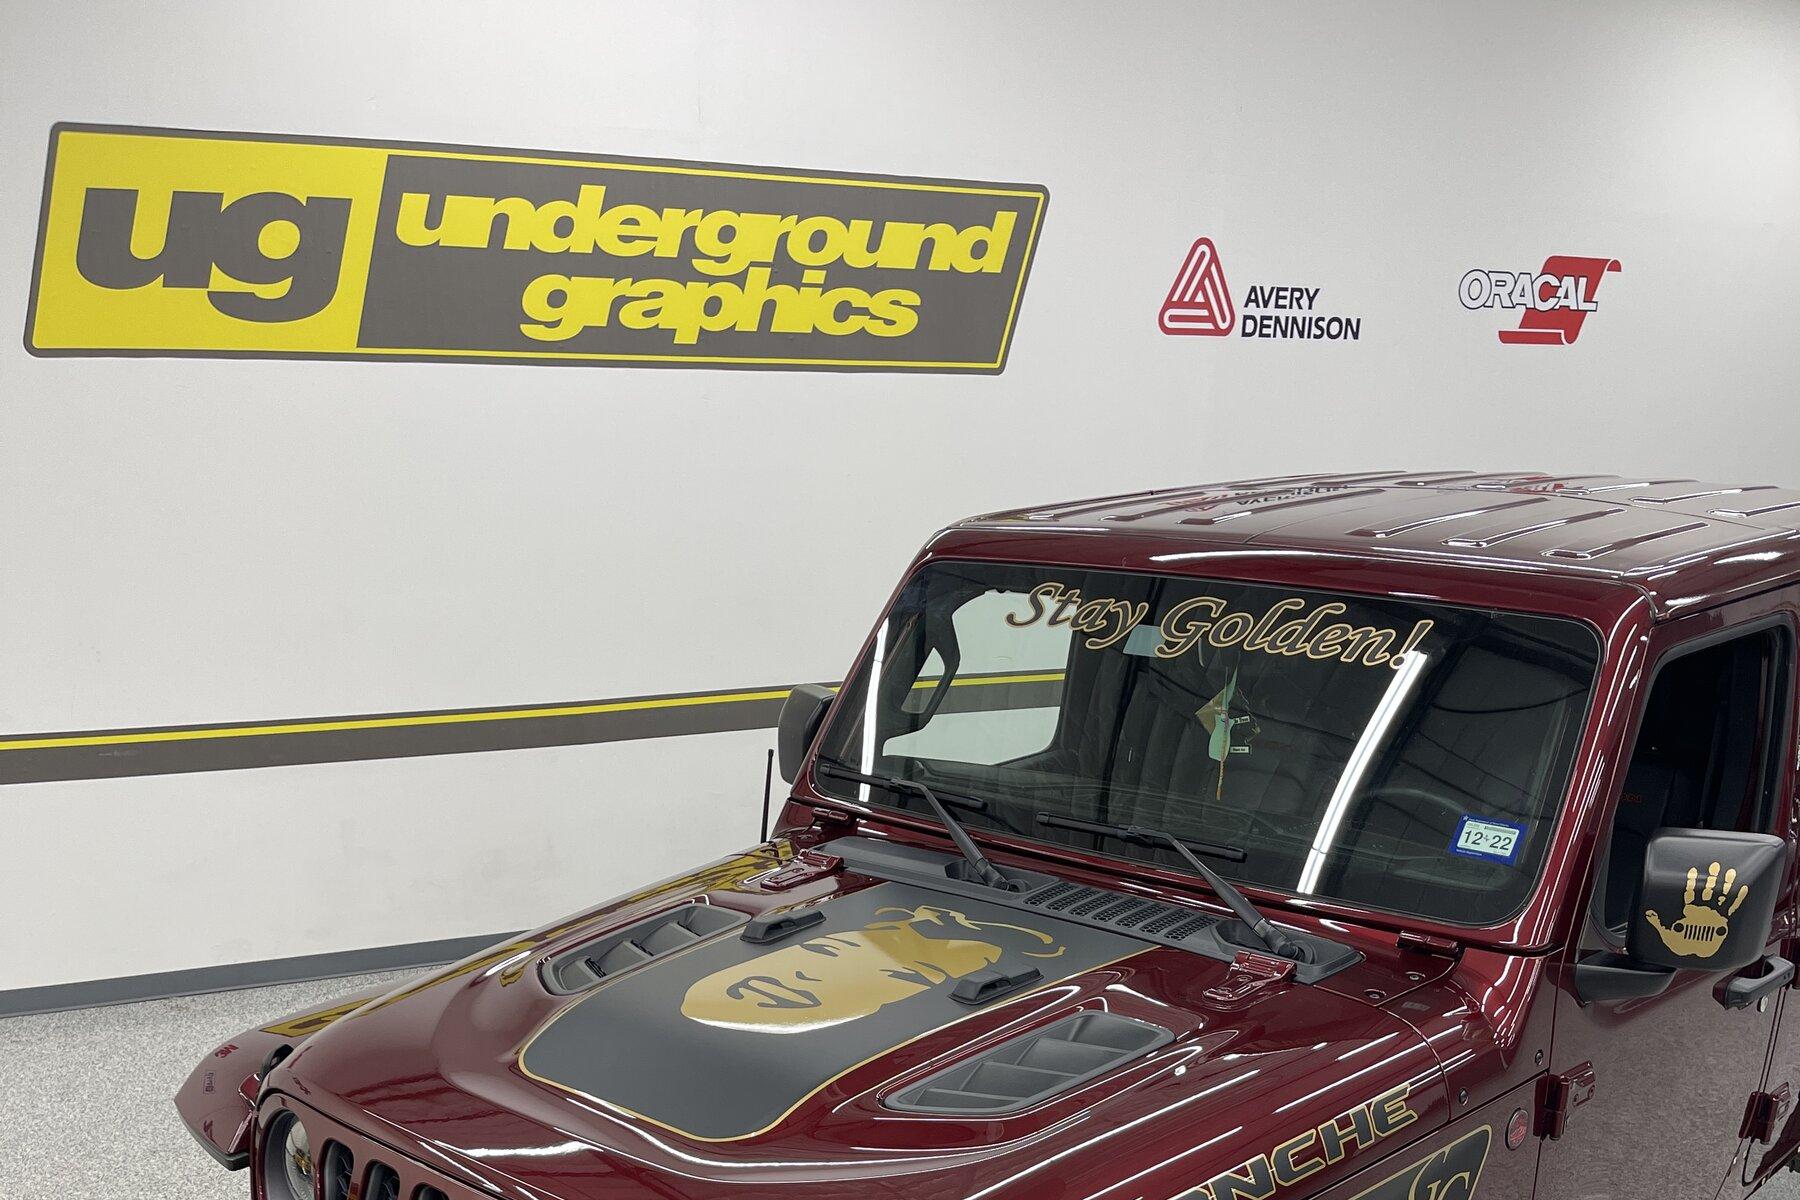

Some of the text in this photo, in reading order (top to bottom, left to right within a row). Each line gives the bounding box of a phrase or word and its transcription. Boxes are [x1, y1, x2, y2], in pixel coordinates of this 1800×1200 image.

[76, 187, 353, 324] ug
[396, 184, 1018, 277] underground
[520, 266, 922, 345] graphics
[1243, 285, 1321, 311] AVERY
[1458, 268, 1599, 313] ORACAL
[1241, 315, 1362, 340] DENNISON
[1005, 581, 1435, 670] Stay Golden!
[1464, 830, 1484, 846] 12
[1489, 834, 1512, 851] 22
